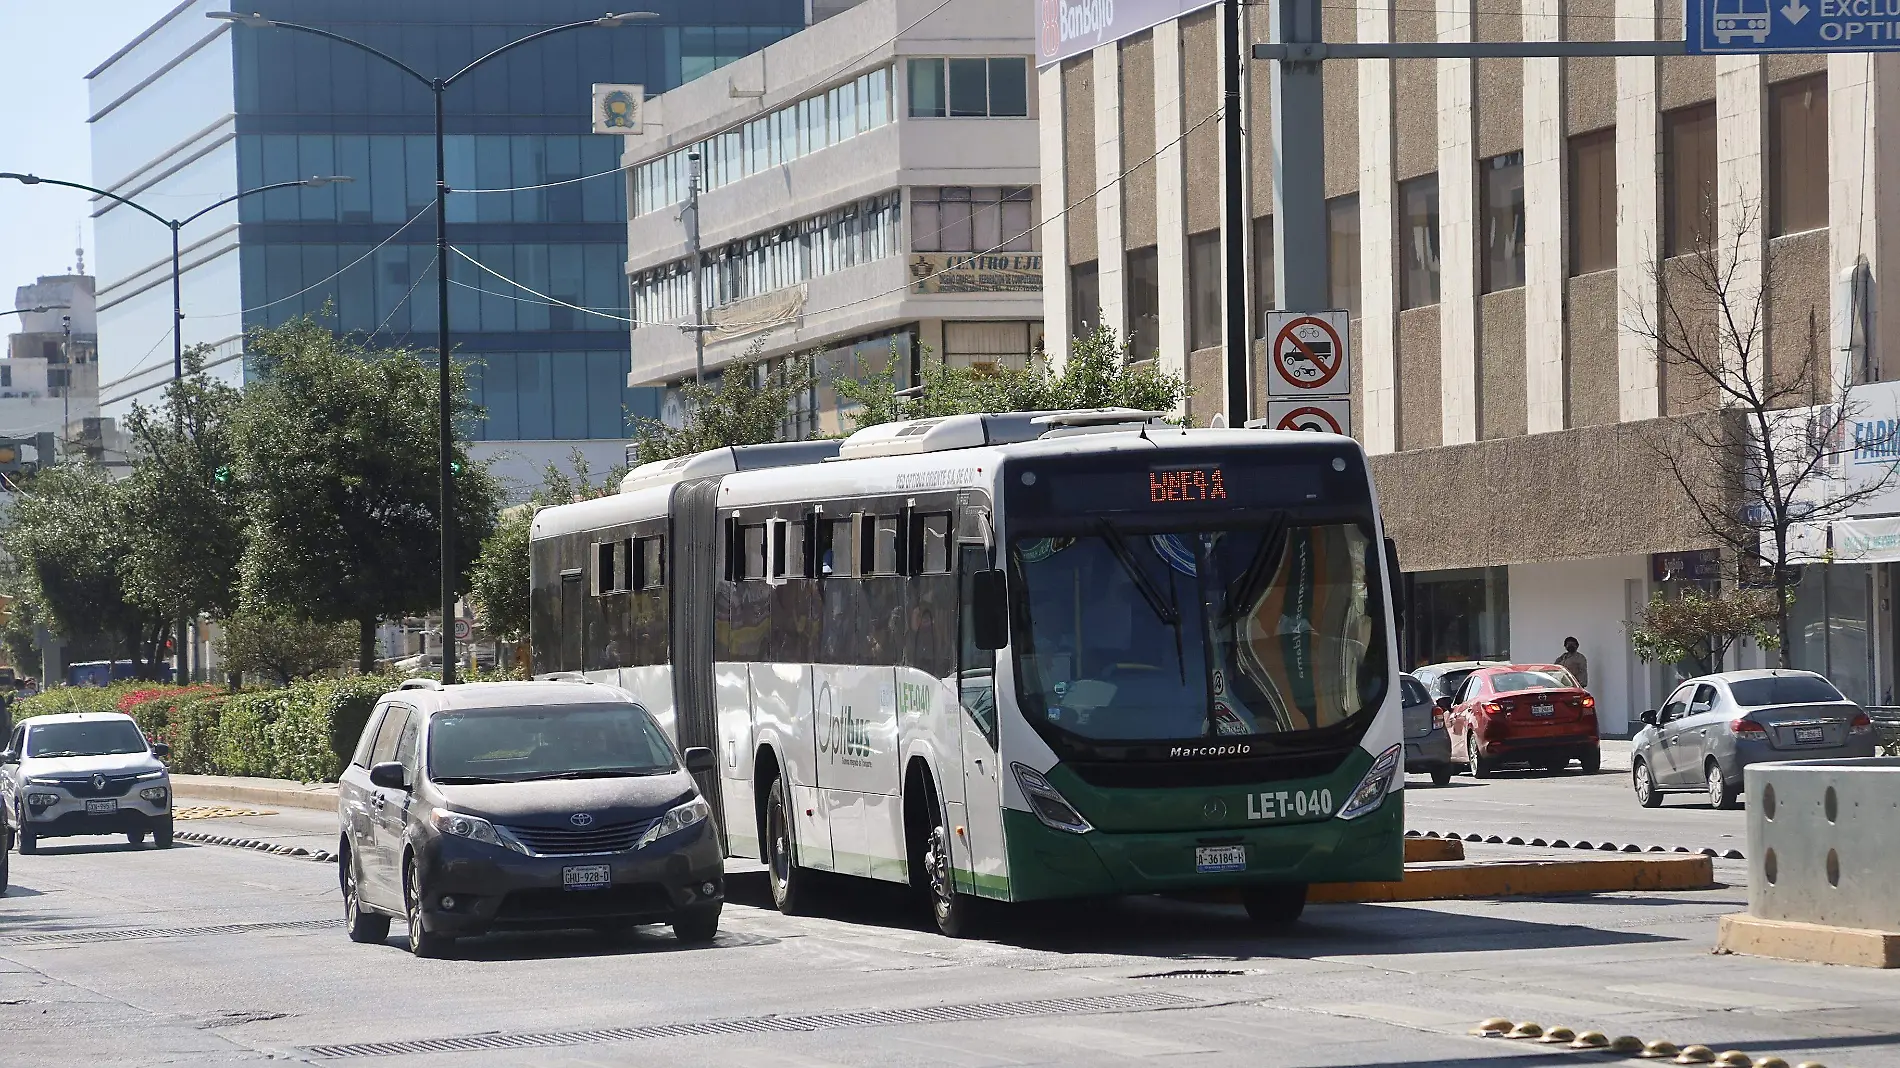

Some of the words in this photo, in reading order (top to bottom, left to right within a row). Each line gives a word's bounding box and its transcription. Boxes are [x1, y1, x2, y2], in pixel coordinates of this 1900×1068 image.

[1820, 22, 1900, 40] OPTI
[946, 256, 1009, 270] CENTRO
[818, 681, 871, 765] Optibus
[1170, 743, 1251, 758] Marcopolo
[1247, 788, 1332, 820] LET-040
[1198, 852, 1244, 865] A-36184-H
[565, 871, 609, 883] GHU-928-D
